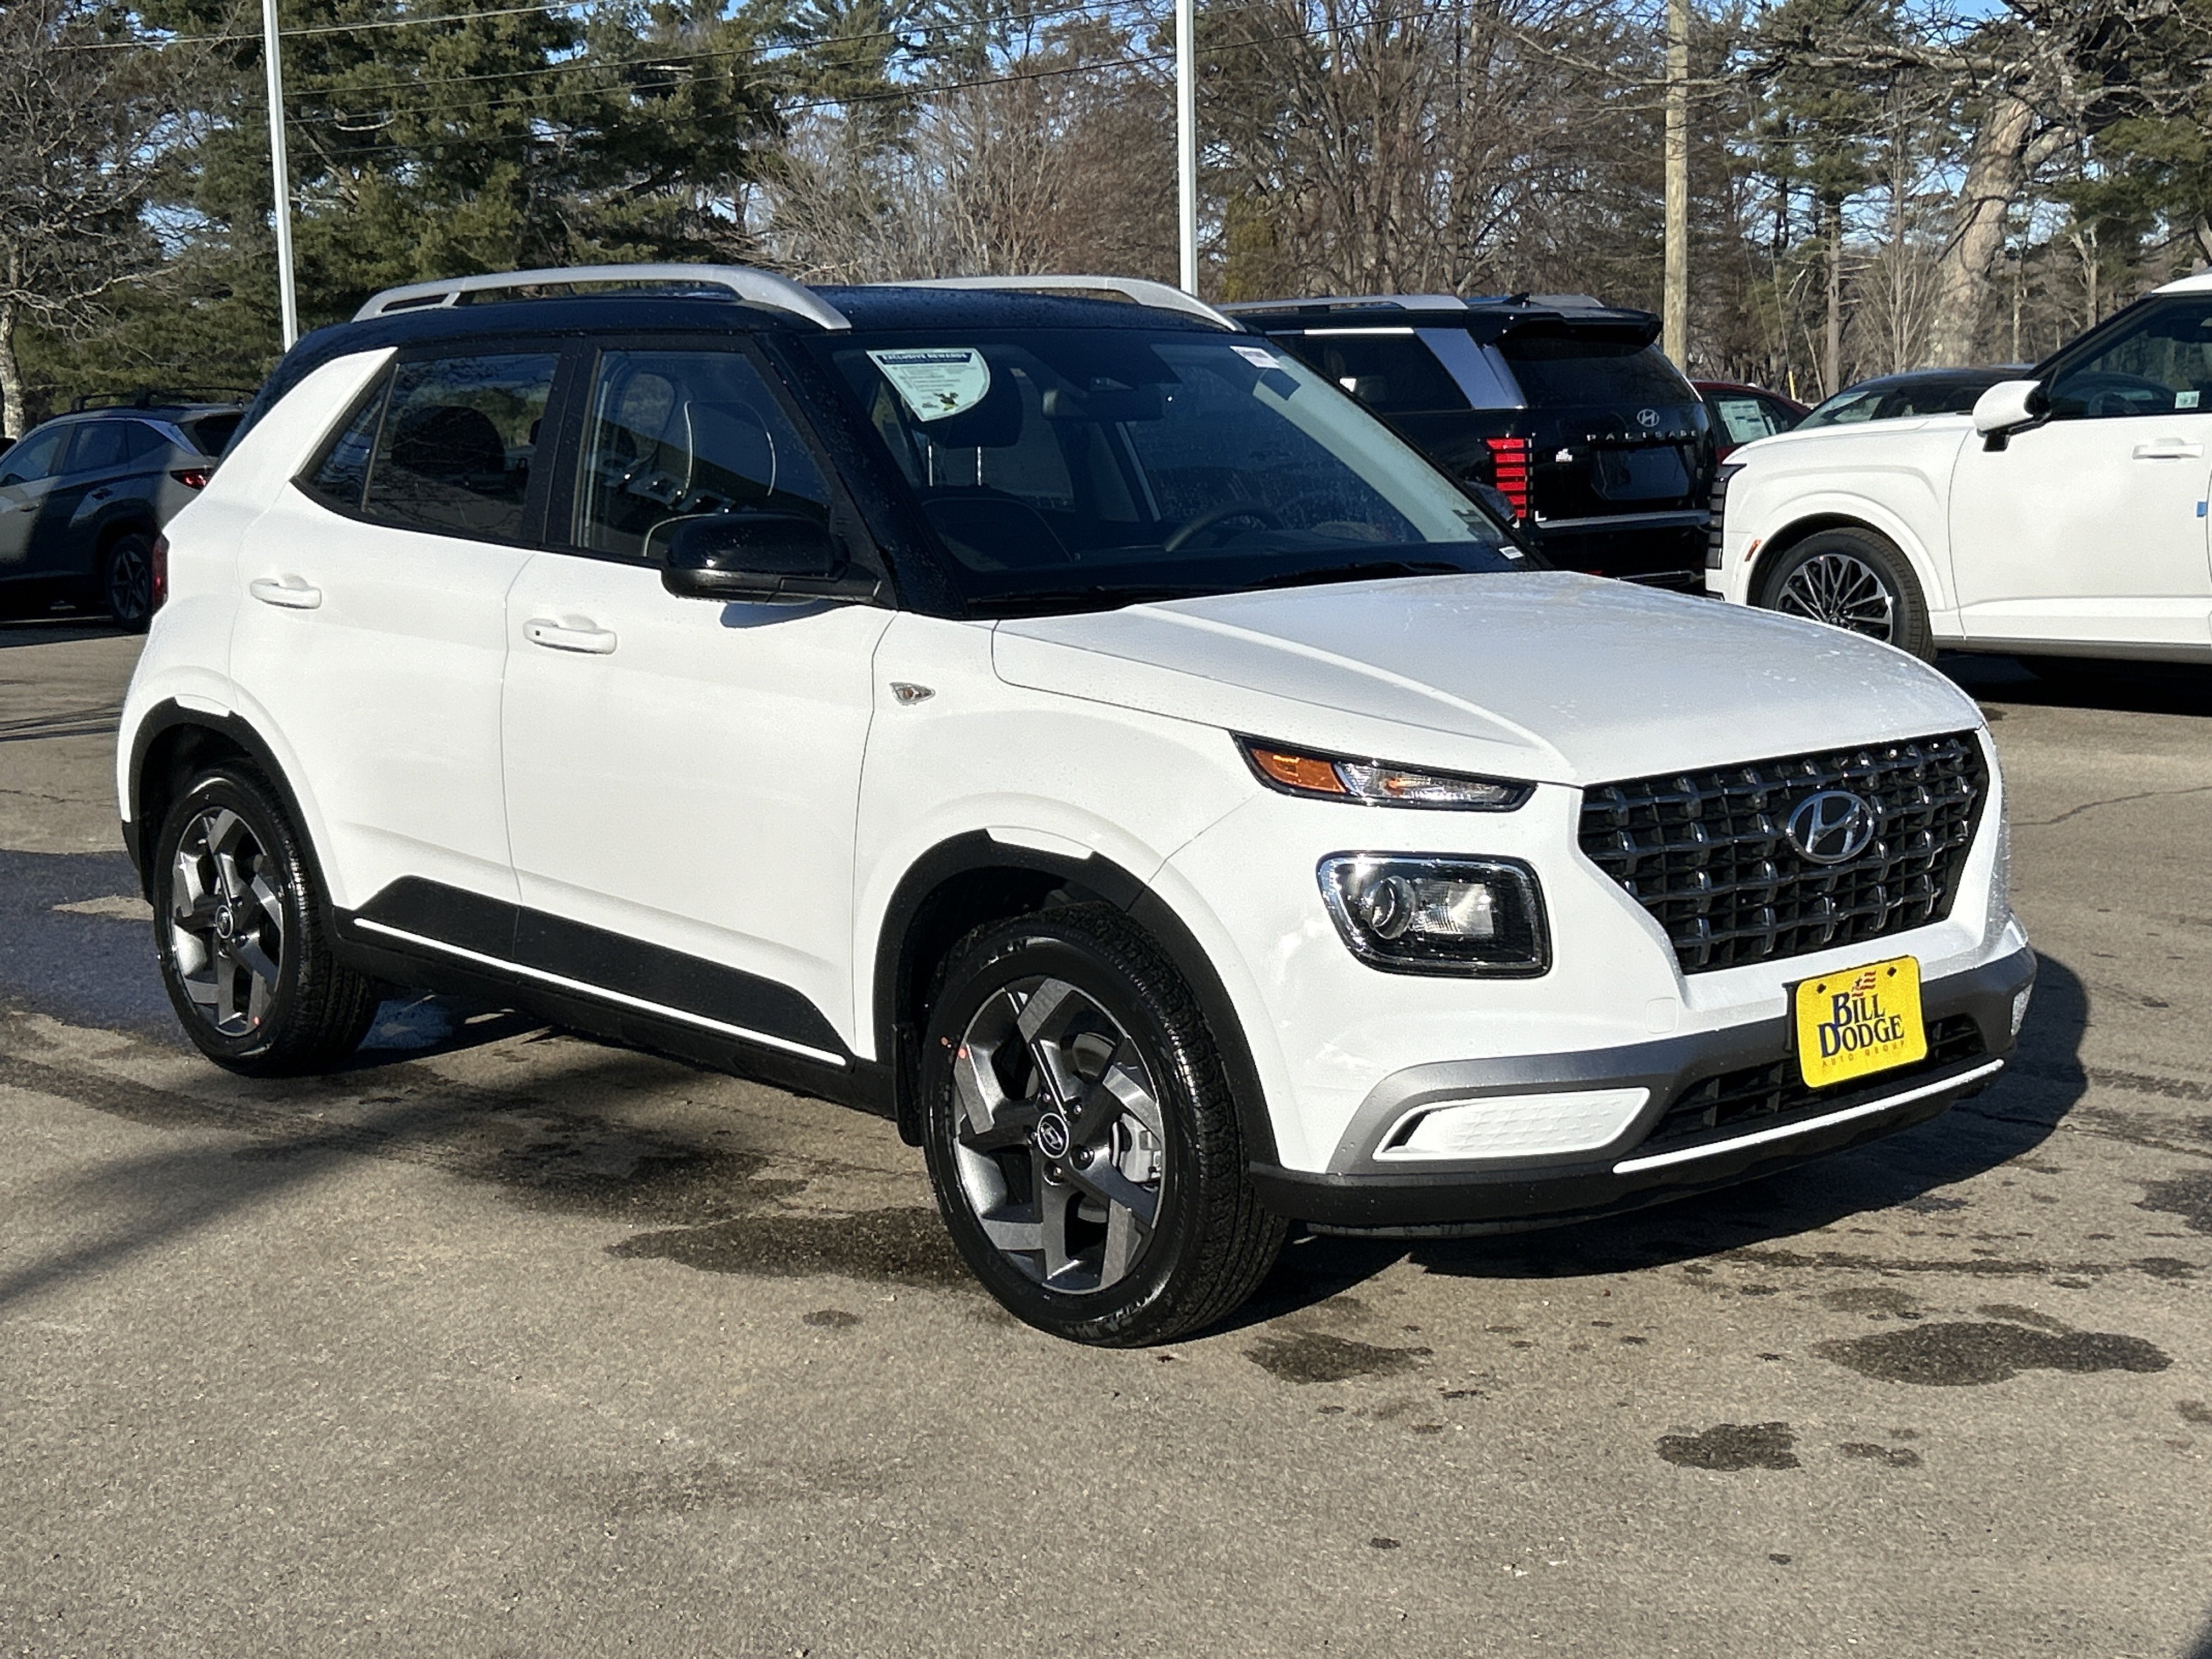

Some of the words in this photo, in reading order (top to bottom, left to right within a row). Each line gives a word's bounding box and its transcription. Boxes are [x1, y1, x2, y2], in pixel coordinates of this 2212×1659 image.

[1587, 430, 1696, 441] PALISADE
[1831, 992, 1886, 1028] BILL
[1817, 1014, 1904, 1058] DODGE
[1822, 1053, 1854, 1068] AUTO
[1865, 1040, 1904, 1057] GROUP
